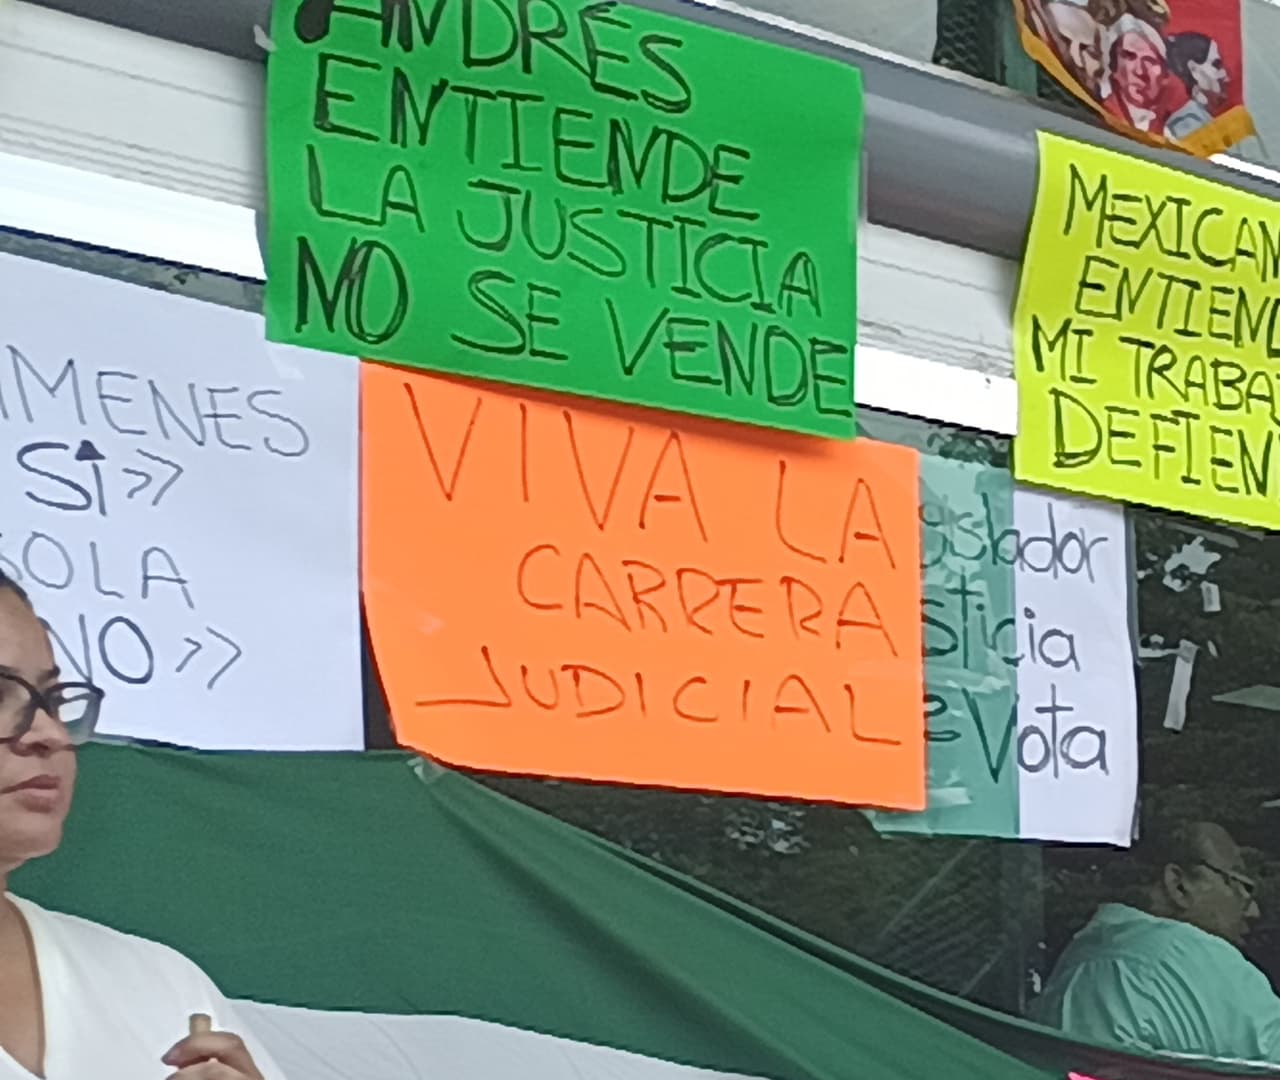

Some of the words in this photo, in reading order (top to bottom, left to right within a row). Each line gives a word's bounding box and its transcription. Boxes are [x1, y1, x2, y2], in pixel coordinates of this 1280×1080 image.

[294, 0, 691, 113] ANDRES
[313, 52, 762, 221] ENTIENDE
[306, 144, 426, 234] LA
[456, 179, 823, 318] JUSTICIA
[294, 236, 409, 346] NO
[451, 270, 570, 362] SE
[603, 297, 857, 420] VENDE
[1031, 314, 1097, 385] MI
[0, 344, 310, 457] MENES
[403, 381, 708, 543] VIVA
[775, 458, 896, 570] LA
[516, 543, 899, 656] CARRERA
[415, 645, 903, 747] JUDICIAL
